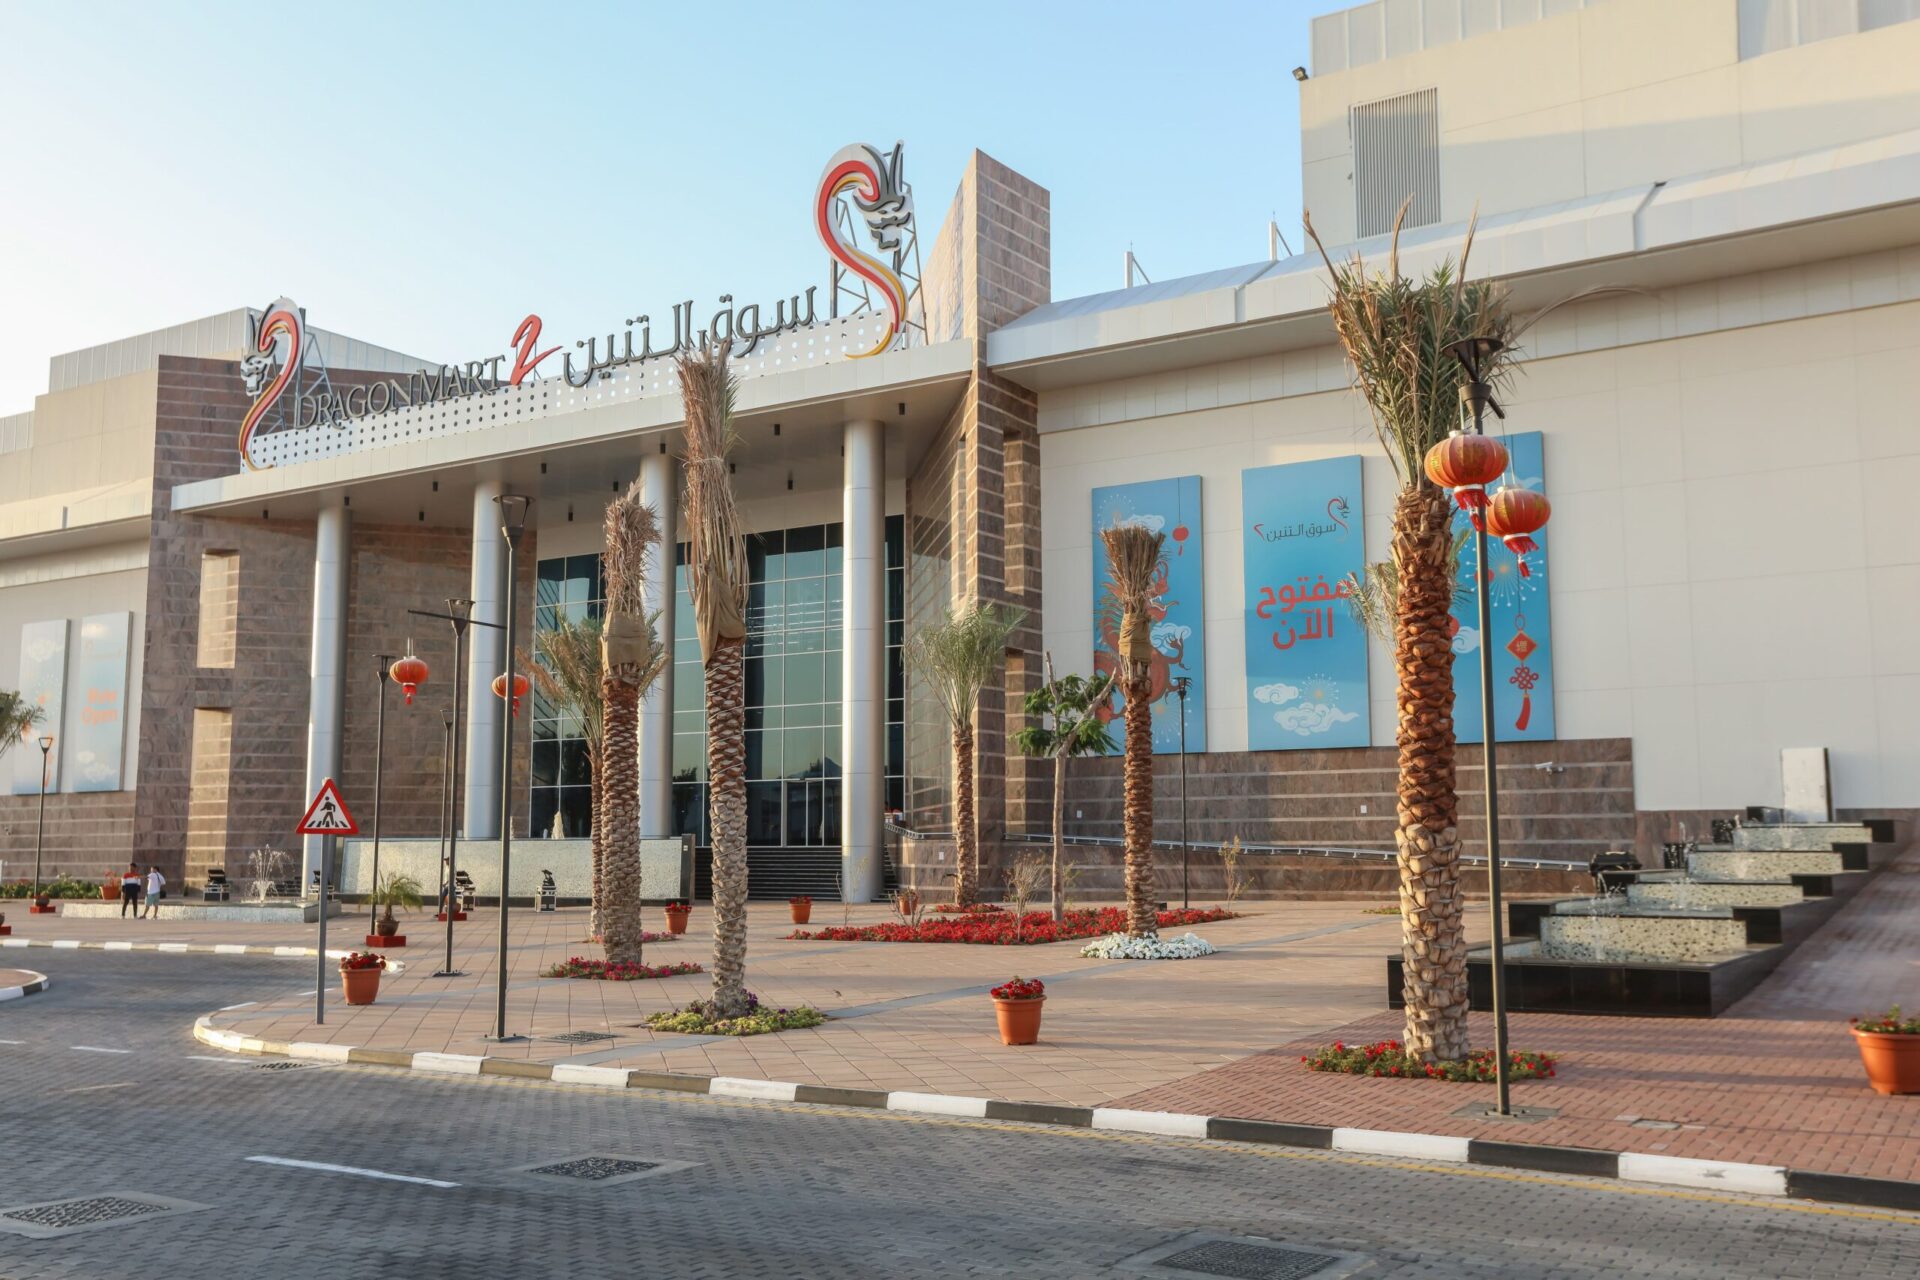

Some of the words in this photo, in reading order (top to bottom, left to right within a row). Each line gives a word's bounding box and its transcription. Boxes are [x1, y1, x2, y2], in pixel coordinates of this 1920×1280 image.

[511, 314, 563, 385] 2
[563, 300, 694, 387] التنين
[697, 286, 817, 359] سوق
[1256, 575, 1354, 619] مفتوح
[1272, 607, 1333, 649] الآن
